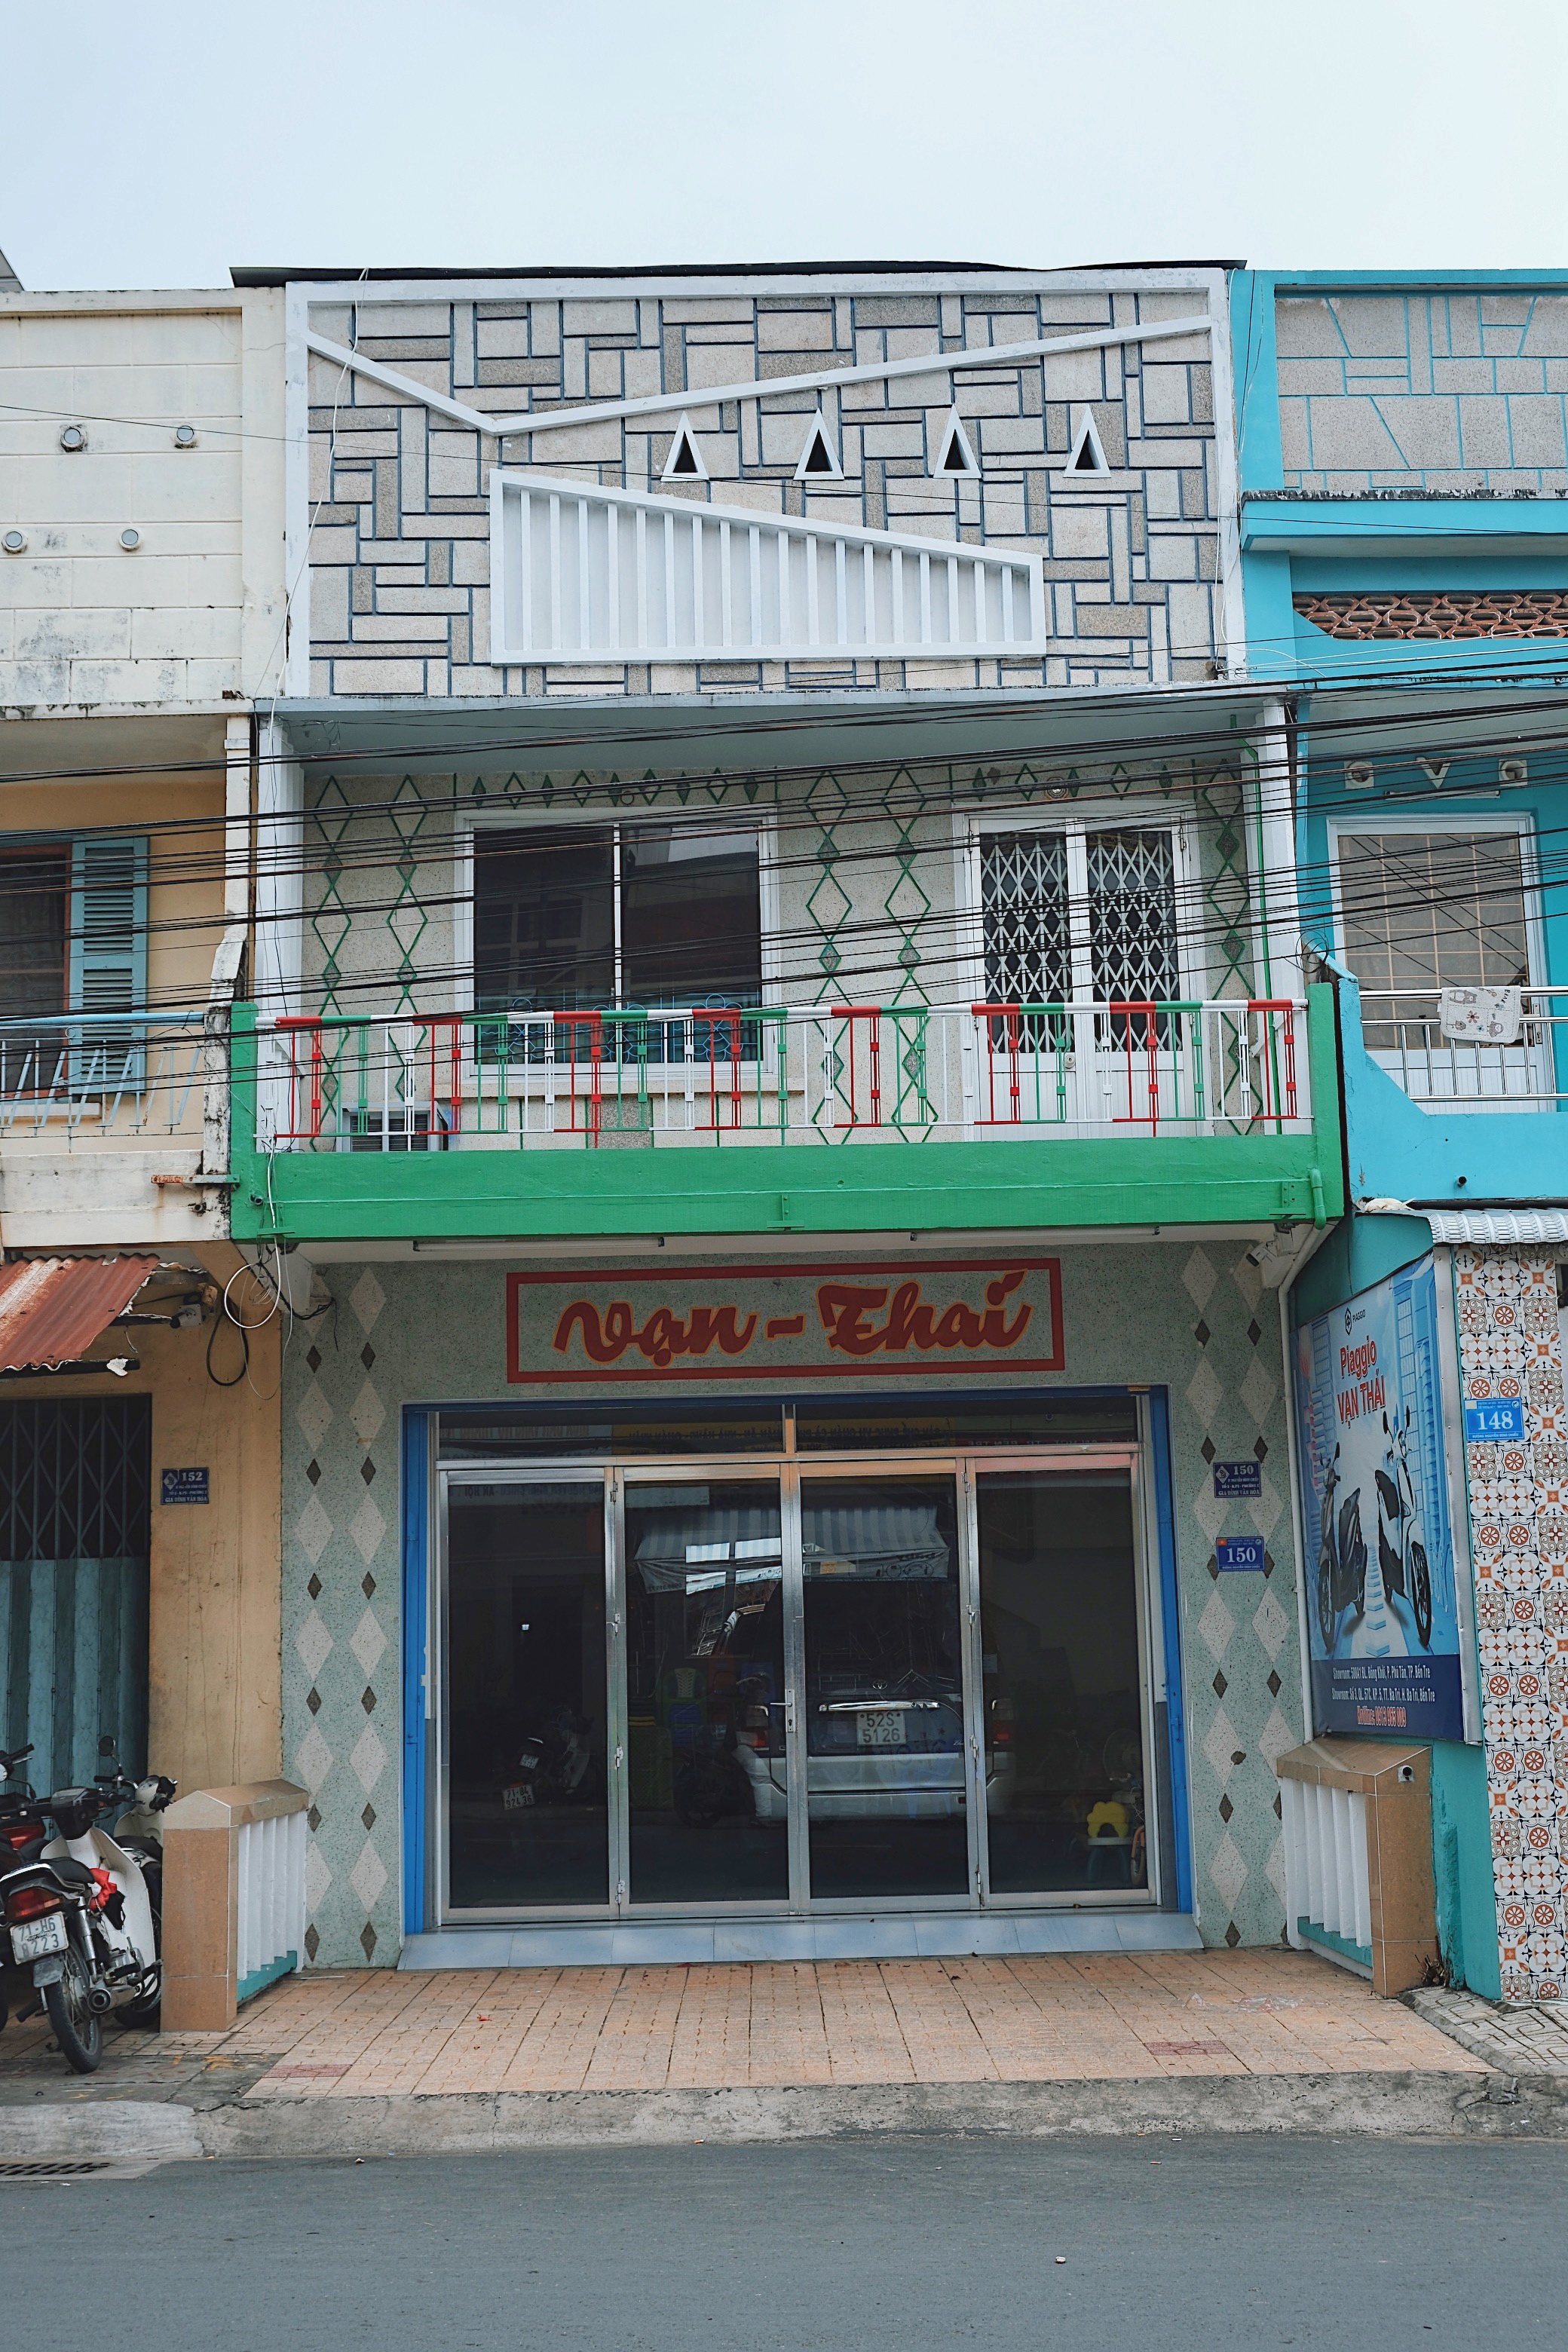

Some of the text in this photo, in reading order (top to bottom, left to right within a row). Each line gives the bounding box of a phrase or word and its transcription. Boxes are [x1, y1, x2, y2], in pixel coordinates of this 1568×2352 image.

[1352, 1309, 1366, 1324] PIAGGIO
[1340, 1335, 1377, 1380] Piaggio
[1337, 1367, 1386, 1429] VẠN THÁI
[1477, 1410, 1513, 1430] 148
[182, 1472, 203, 1481] 152
[1234, 1465, 1254, 1475] 150
[1227, 1547, 1256, 1563] 150
[1399, 1665, 1408, 1680] Tân,
[1415, 1663, 1423, 1678] Bến
[1389, 1688, 1395, 1701] Ba
[1407, 1688, 1412, 1701] Ba
[1419, 1686, 1428, 1702] Bến
[867, 1712, 894, 1727] 52S
[862, 1728, 900, 1744] 5126
[21, 1933, 59, 1958] 8223
